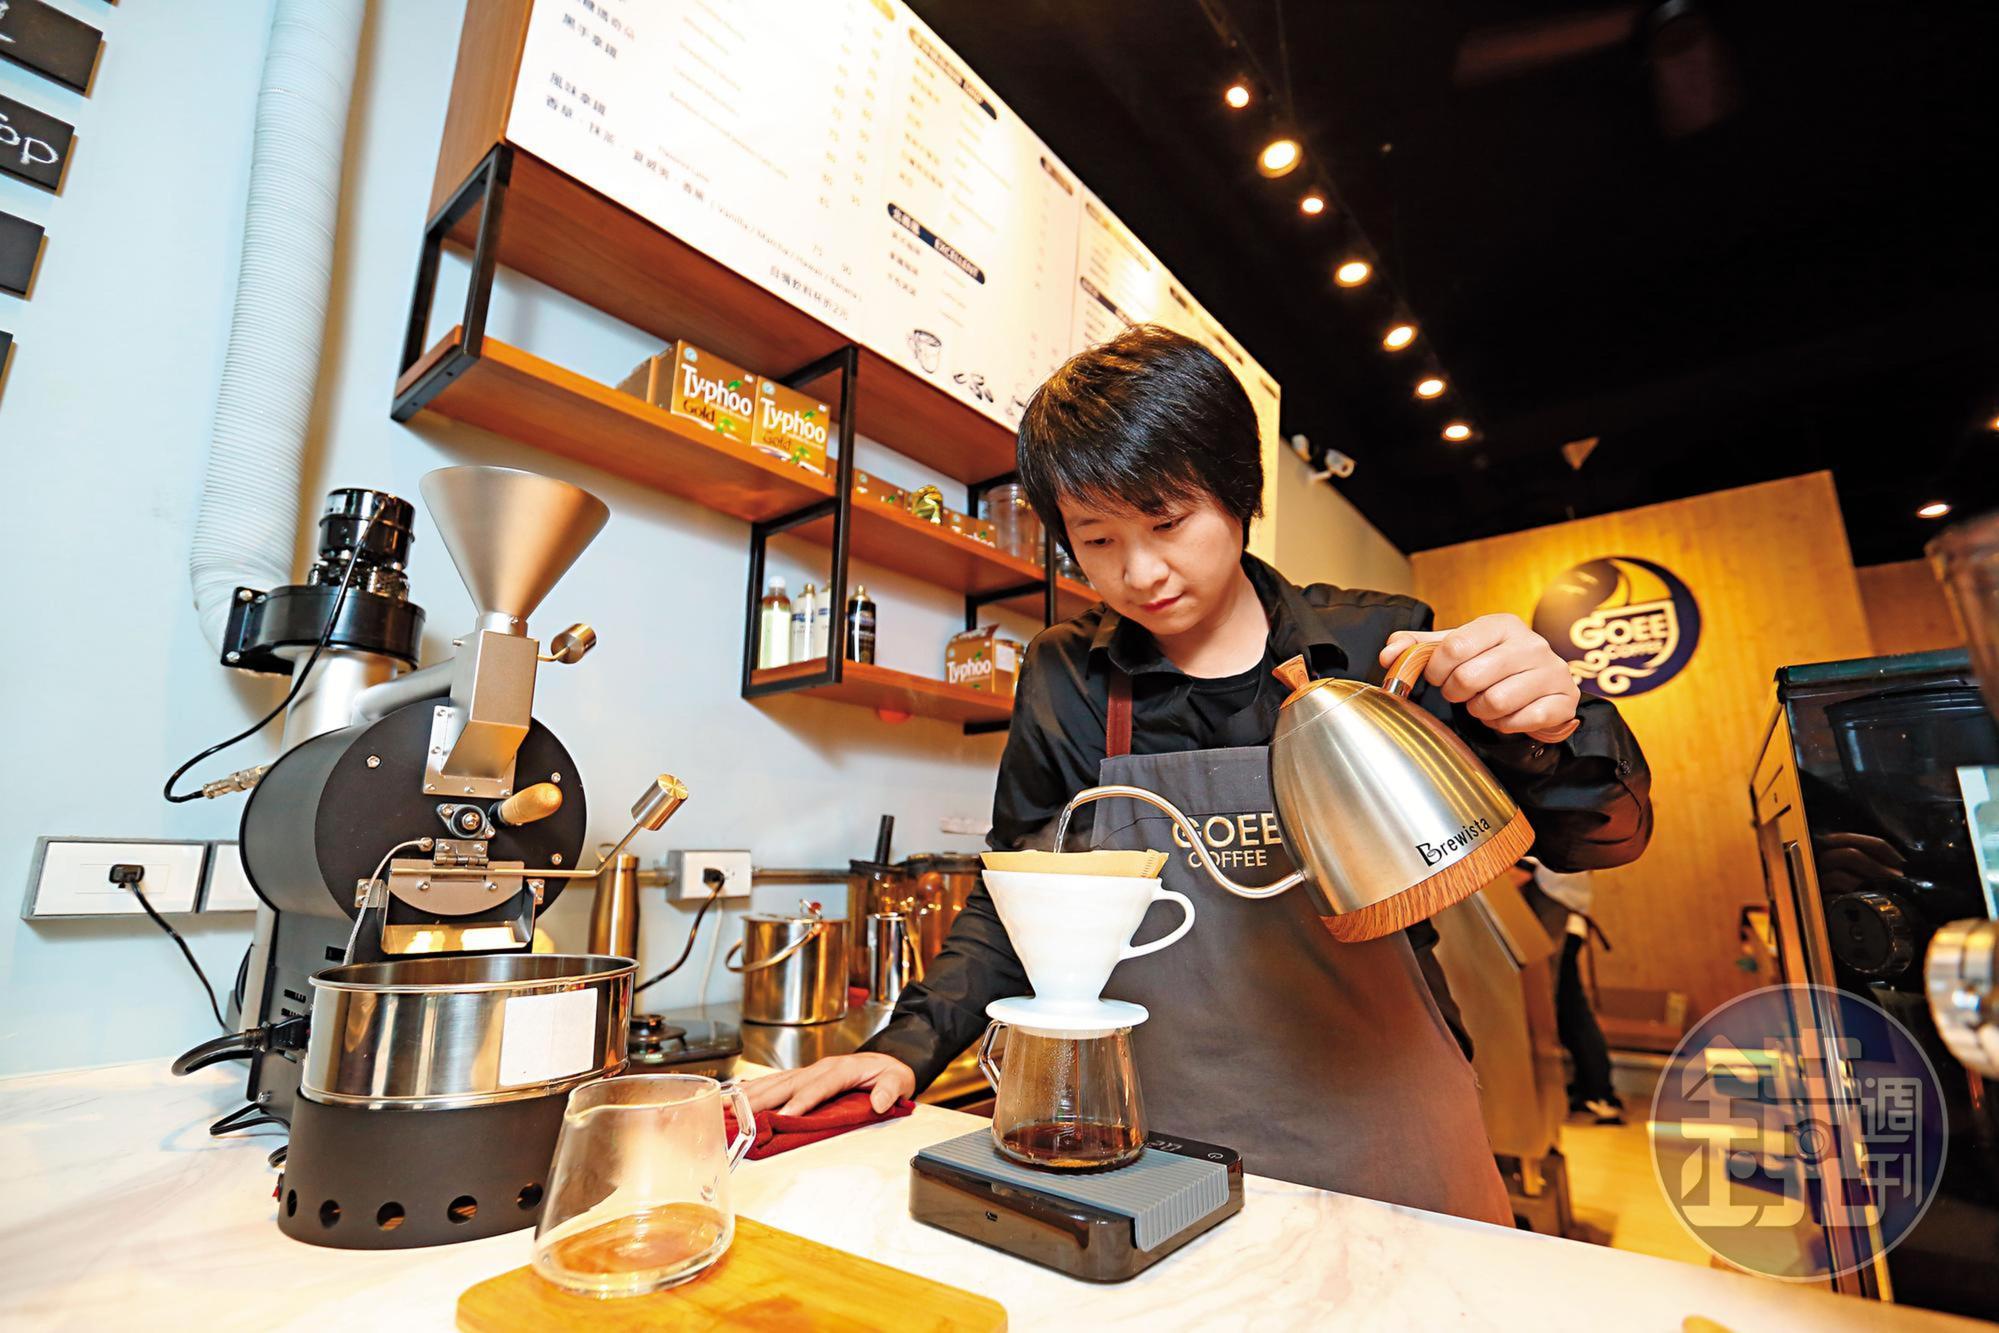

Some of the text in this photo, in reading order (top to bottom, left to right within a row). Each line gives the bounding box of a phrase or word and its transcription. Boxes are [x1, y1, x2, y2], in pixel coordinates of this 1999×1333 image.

[681, 362, 753, 417] Typhoo
[683, 399, 716, 424] Gold
[760, 396, 827, 444] Typhoo
[763, 430, 792, 451] Gold
[946, 657, 992, 684] Typhoo
[1415, 818, 1491, 867] Brewista
